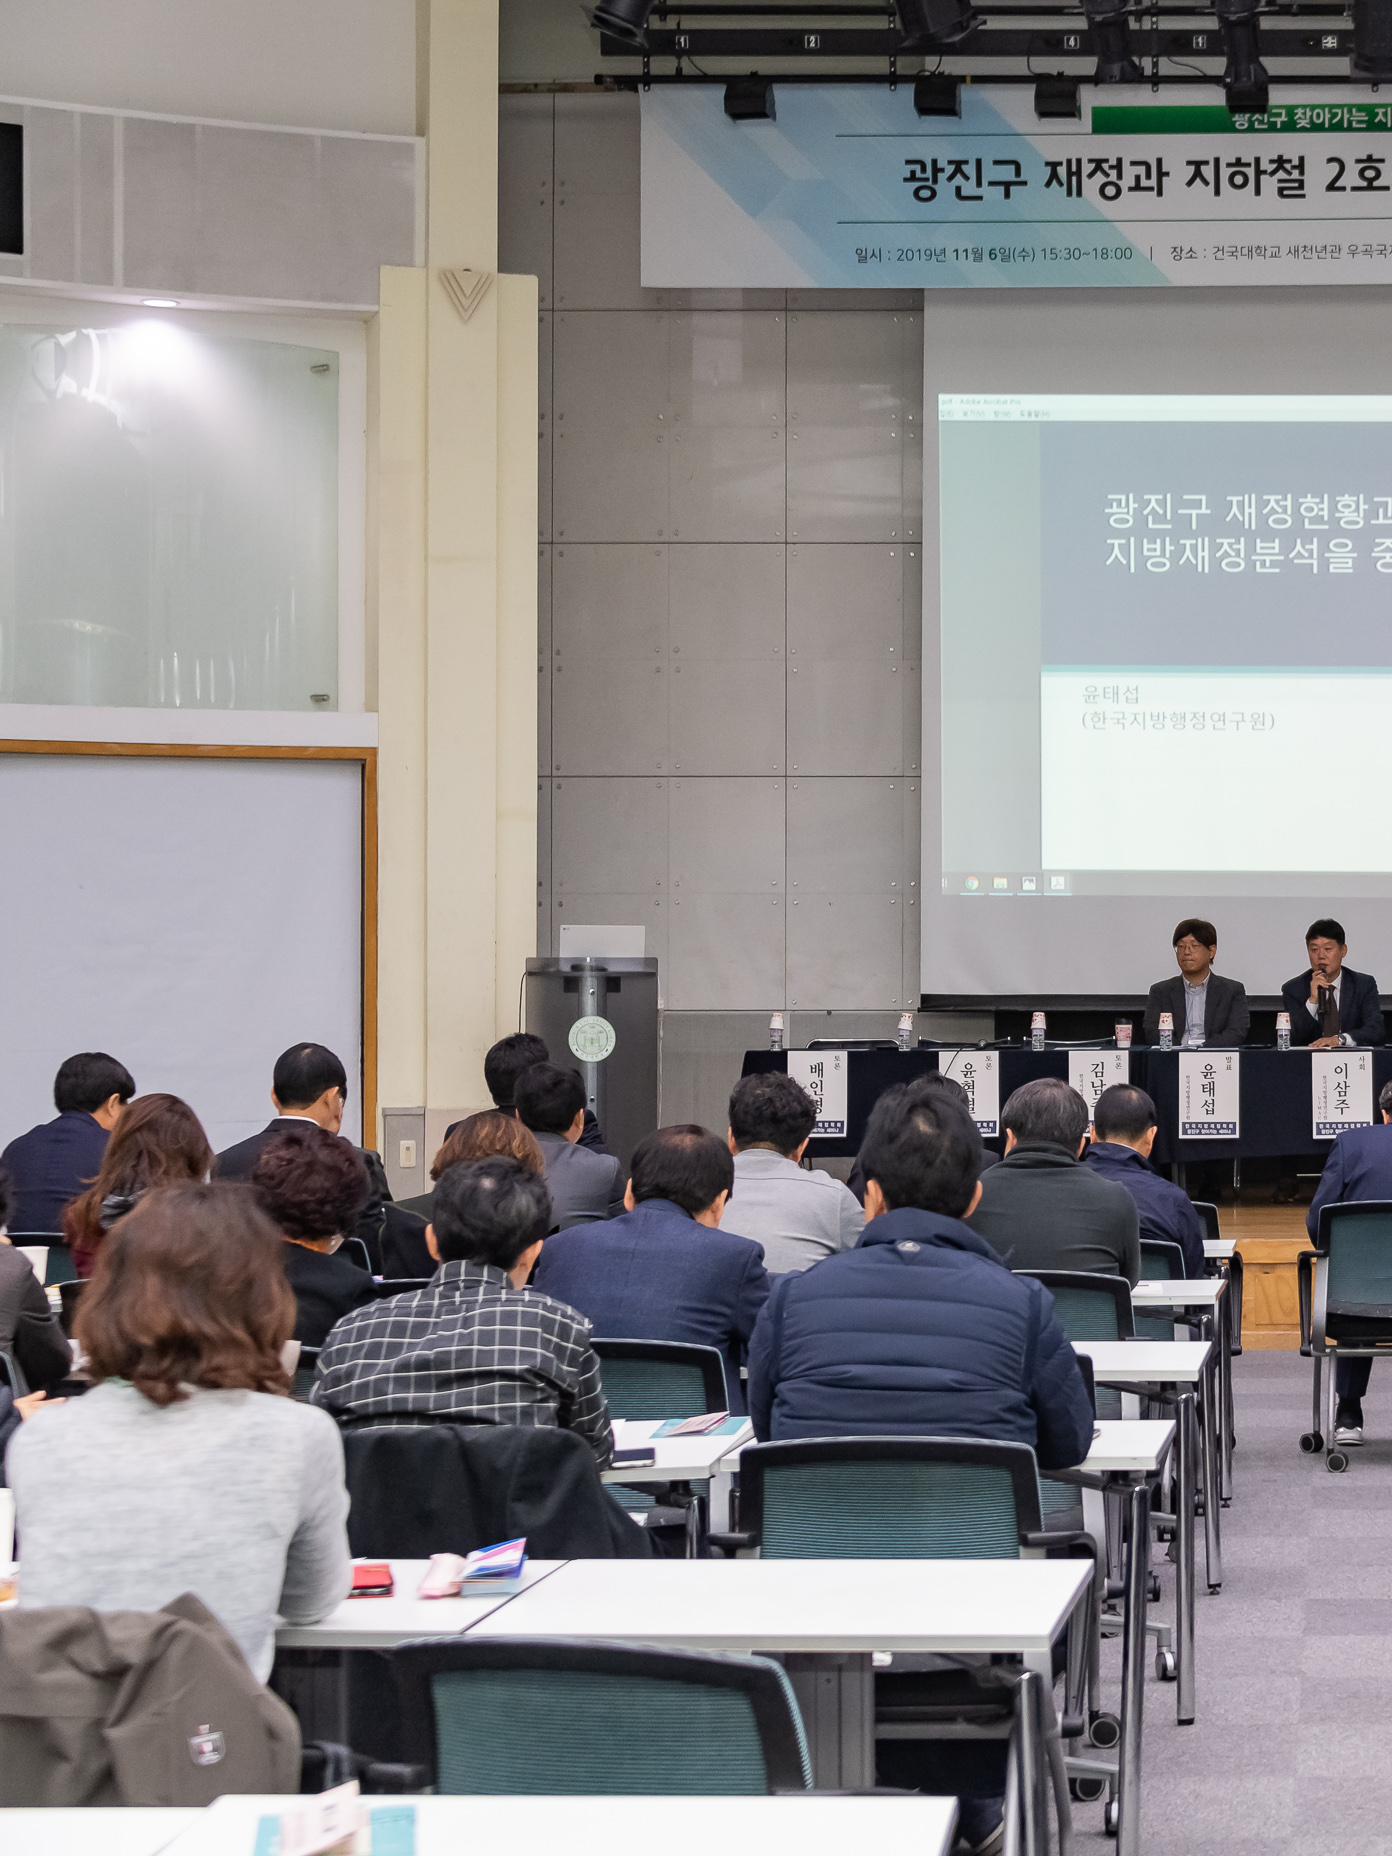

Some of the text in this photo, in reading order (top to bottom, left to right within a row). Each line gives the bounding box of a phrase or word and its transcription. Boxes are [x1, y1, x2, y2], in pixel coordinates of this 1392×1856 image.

[1294, 107, 1368, 128] 찾아가는
[902, 157, 1029, 203] 광진구
[1043, 156, 1171, 202] 재정과
[1184, 154, 1307, 200] 지하철
[855, 247, 882, 264] 일시
[896, 247, 947, 263] 2019년
[952, 247, 984, 263] 11월
[988, 247, 1036, 263] 6일(수)
[1041, 247, 1133, 261] 15:30~18:00
[1170, 246, 1198, 262] 장소
[1212, 245, 1282, 261] 건국대학교
[1286, 244, 1343, 260] 새천년관
[1104, 492, 1212, 531] 광진구
[1105, 536, 1358, 574] 지방재정분석을
[1082, 685, 1139, 705] 윤태섭
[1082, 710, 1275, 732] (한국지방행정연구원)
[1225, 1056, 1232, 1071] 발표
[1358, 1055, 1366, 1071] 사회
[1200, 1063, 1216, 1115] 윤태섭
[1333, 1062, 1350, 1115] 이삼주
